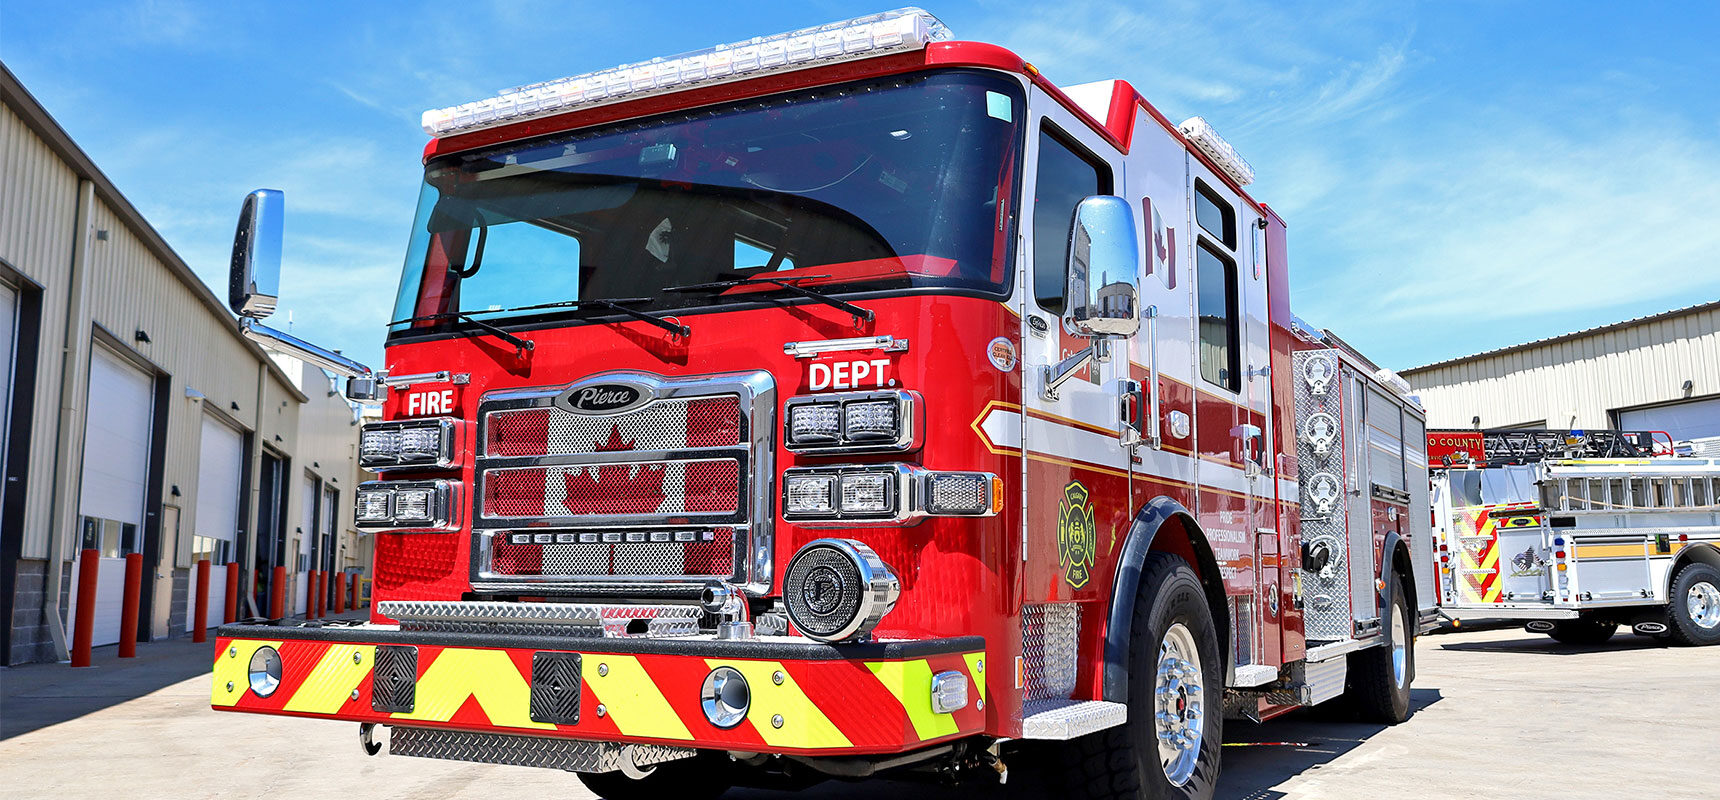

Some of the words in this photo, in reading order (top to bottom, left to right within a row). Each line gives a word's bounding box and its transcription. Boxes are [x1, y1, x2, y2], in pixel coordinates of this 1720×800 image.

[809, 359, 896, 391] DEPT.
[408, 389, 454, 417] FIRE
[577, 387, 631, 409] Pierce
[1440, 438, 1481, 450] COUNTY
[1220, 511, 1232, 524] PRIDE
[1206, 528, 1246, 543] PROFESSIONALISM
[1215, 548, 1239, 560] TEAMWORK
[1072, 569, 1082, 579] FIRE
